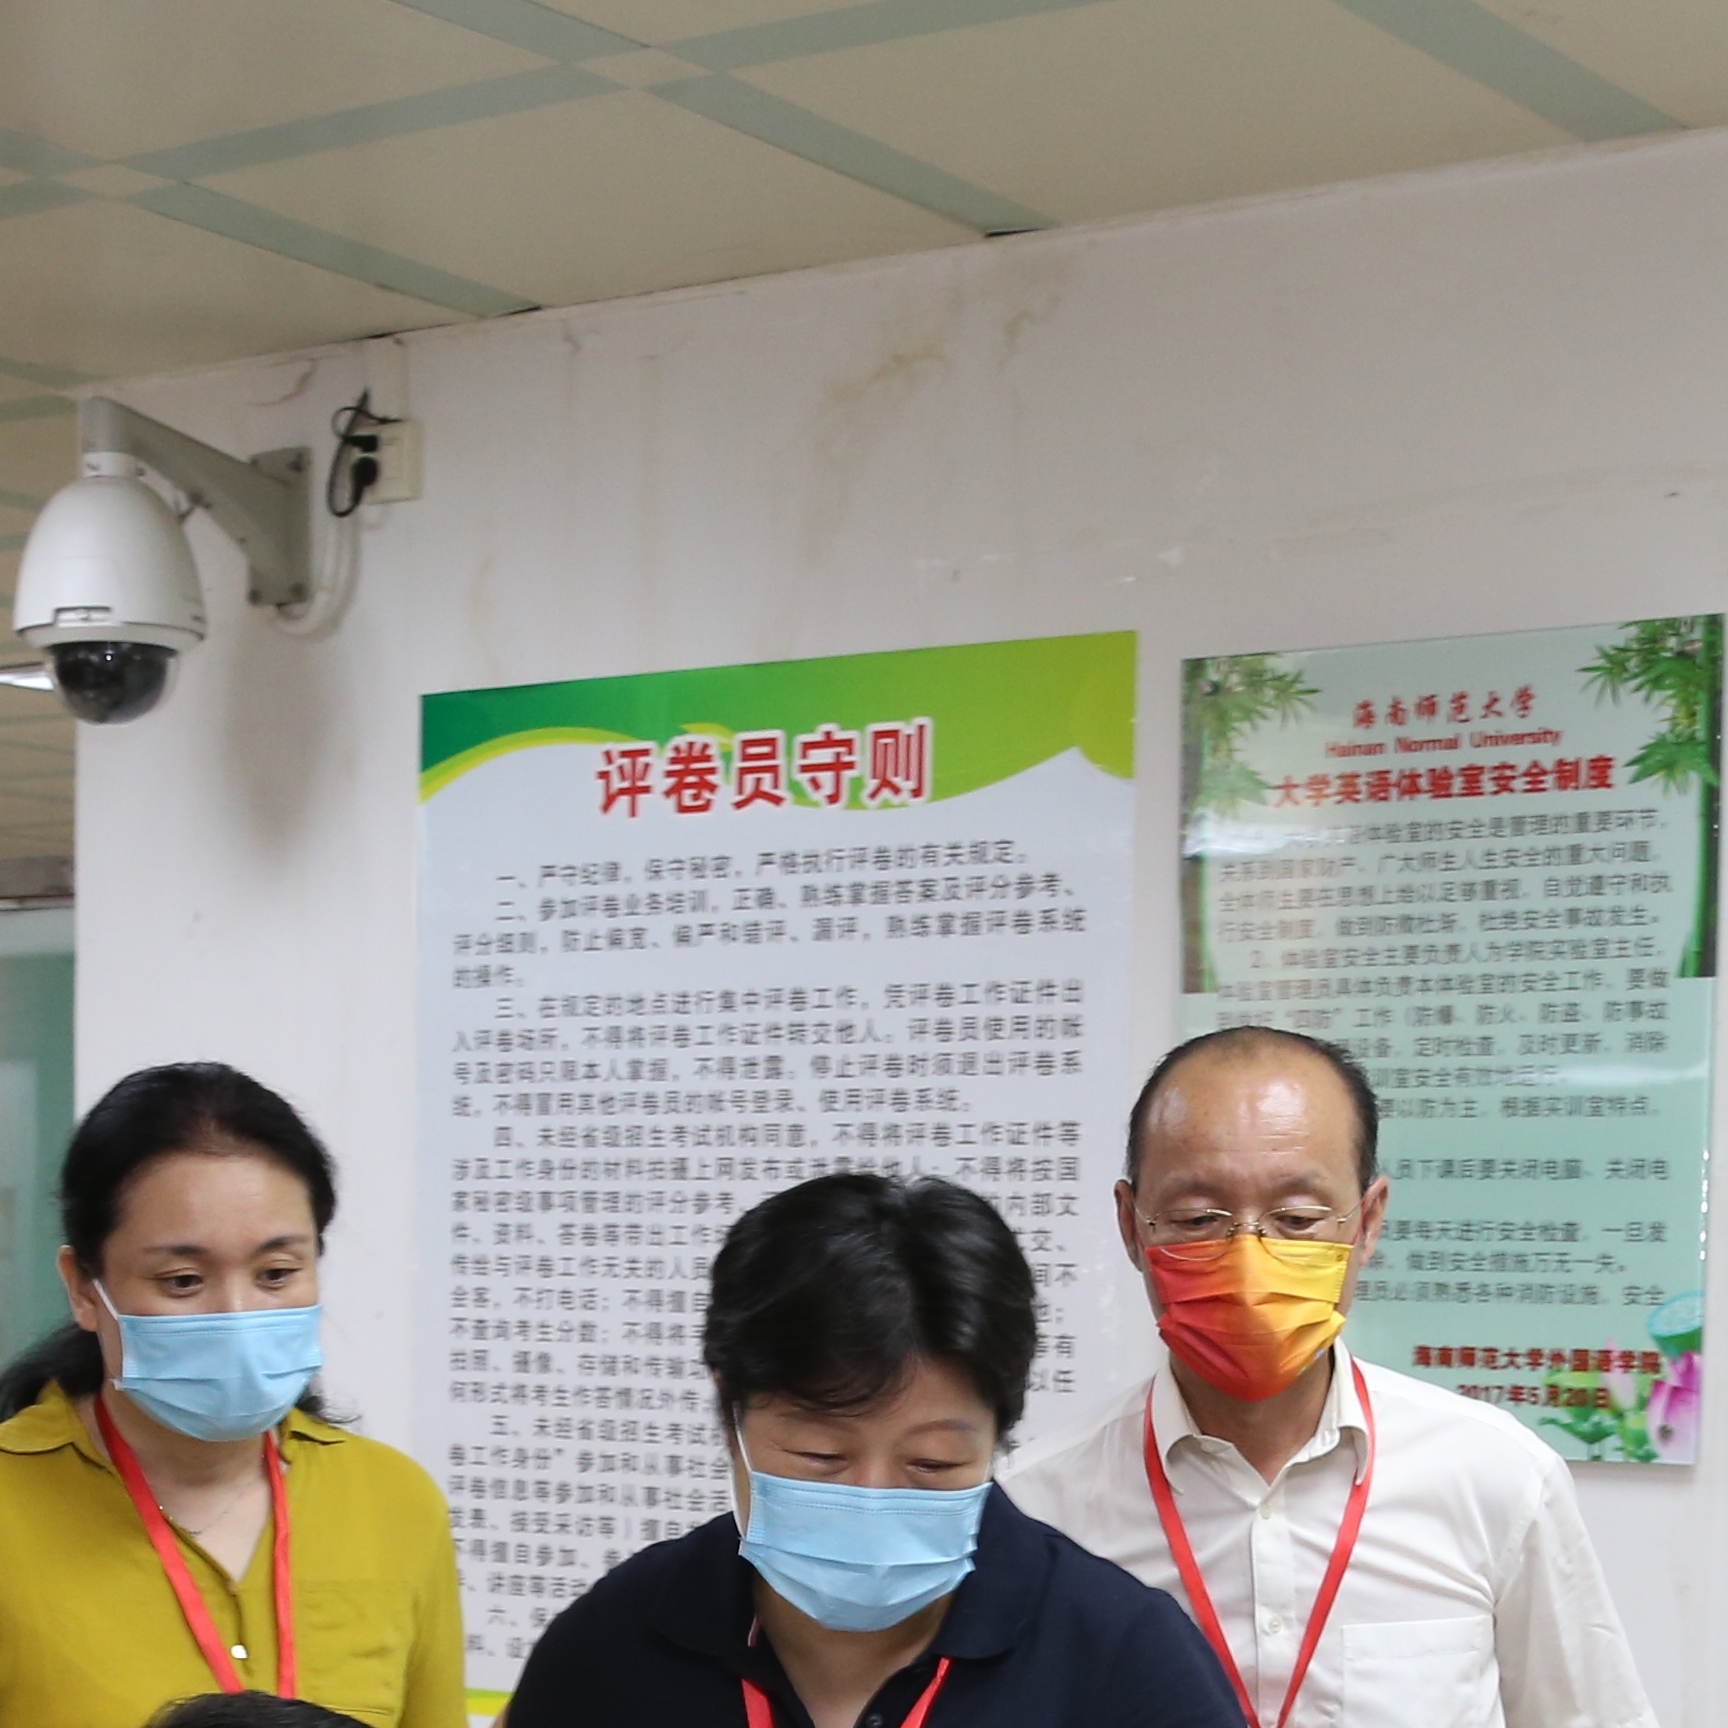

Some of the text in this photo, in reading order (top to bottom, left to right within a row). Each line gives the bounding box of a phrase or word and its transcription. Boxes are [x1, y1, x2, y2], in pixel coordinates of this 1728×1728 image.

[1352, 684, 1538, 728] 海南师范大学
[1324, 724, 1563, 761] Hainan Normal University
[596, 724, 932, 817] 评卷员守则
[1273, 755, 1617, 808] 大学英语体验室安全制度
[1412, 1343, 1662, 1374] 海南师范大学外国语学院
